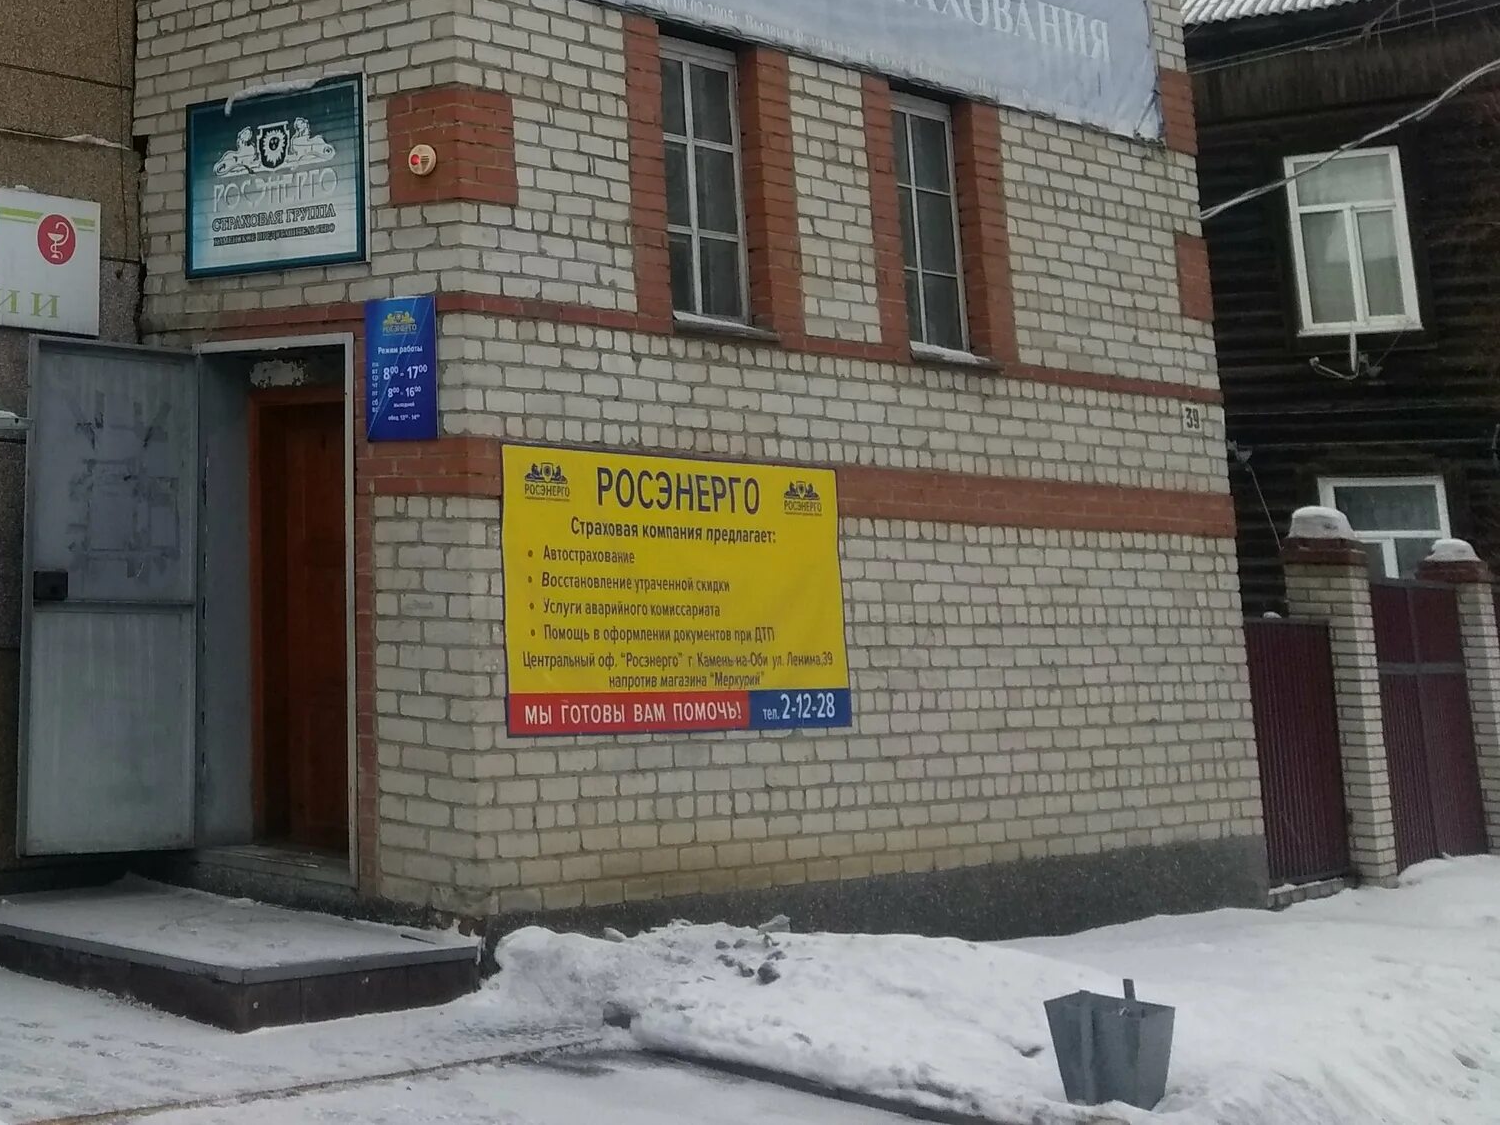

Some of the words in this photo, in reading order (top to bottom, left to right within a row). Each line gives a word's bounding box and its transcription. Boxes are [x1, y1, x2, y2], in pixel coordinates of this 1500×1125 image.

[211, 209, 284, 232] СТРАХОВАЯ
[286, 203, 337, 223] ГРУППА
[378, 347, 399, 355] Режим
[399, 344, 423, 355] работы
[1185, 407, 1200, 428] 39
[524, 483, 570, 498] РОСЭНЕРГО
[596, 466, 760, 515] РОСЭНЕРГО
[784, 499, 822, 513] РОСЭНЕРГО
[571, 516, 638, 539] Страховая
[642, 525, 702, 541] компания
[706, 527, 776, 545] предлагает:
[543, 545, 635, 565] Автострахование
[541, 571, 632, 589] Восстановление
[635, 577, 694, 594] утраченной
[696, 580, 730, 595] скидки
[543, 598, 582, 618] Услуги
[585, 601, 648, 618] аварийного
[650, 604, 721, 620] комиссариата
[544, 624, 590, 642] Помощь
[594, 629, 600, 640] в
[603, 626, 671, 644] оформлении
[673, 628, 732, 645] документов
[734, 630, 752, 644] при
[754, 626, 775, 643] ДТП
[523, 651, 595, 670] Центральный
[598, 652, 617, 671] оф.
[697, 652, 768, 668] Камень-на-Оби
[772, 654, 784, 670] ул.
[786, 650, 834, 668] Ленина,39
[609, 676, 658, 691] напротив
[660, 674, 707, 687] магазина
[525, 705, 552, 725] МЫ
[561, 703, 626, 725] ГОТОВЫ
[633, 703, 666, 723] ВАМ
[673, 701, 743, 722] ПОМОЧЬ!
[762, 708, 780, 721] тел.
[780, 692, 836, 720] 2-12-28
